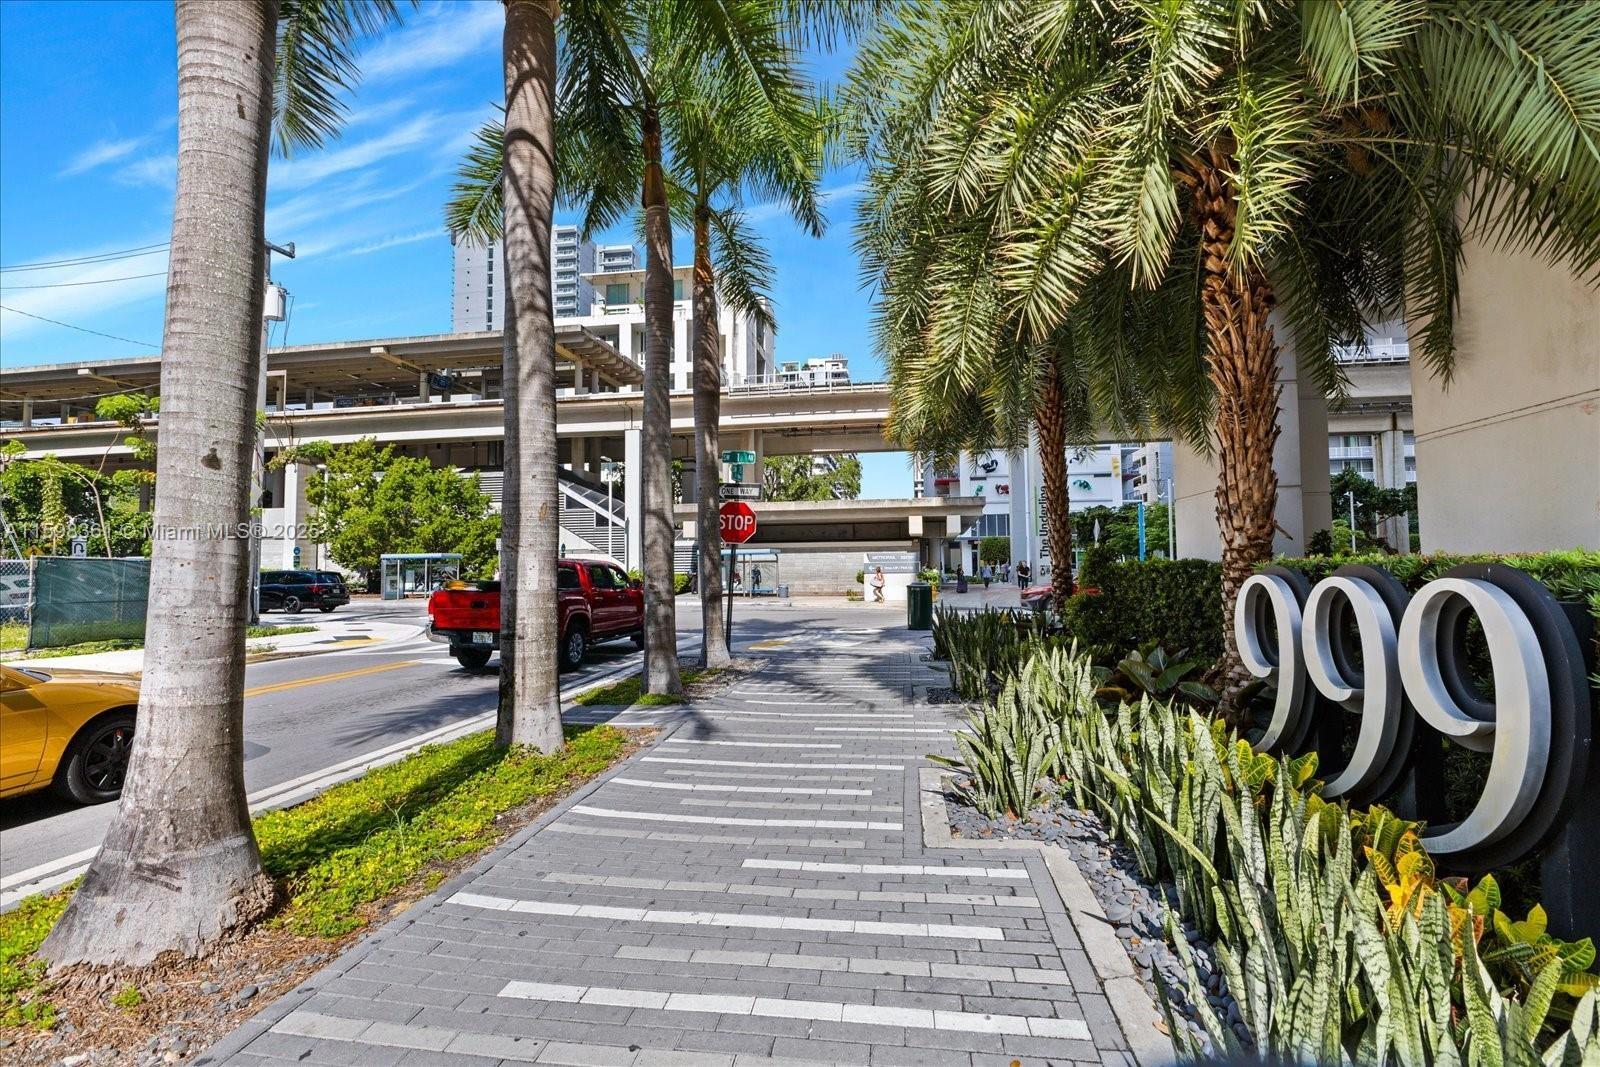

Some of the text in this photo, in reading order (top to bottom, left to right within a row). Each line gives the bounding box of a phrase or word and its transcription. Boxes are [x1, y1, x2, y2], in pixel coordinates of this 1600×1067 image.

[719, 515, 753, 531] STOP
[1040, 539, 1050, 559] The
[1234, 573, 1552, 855] 999
